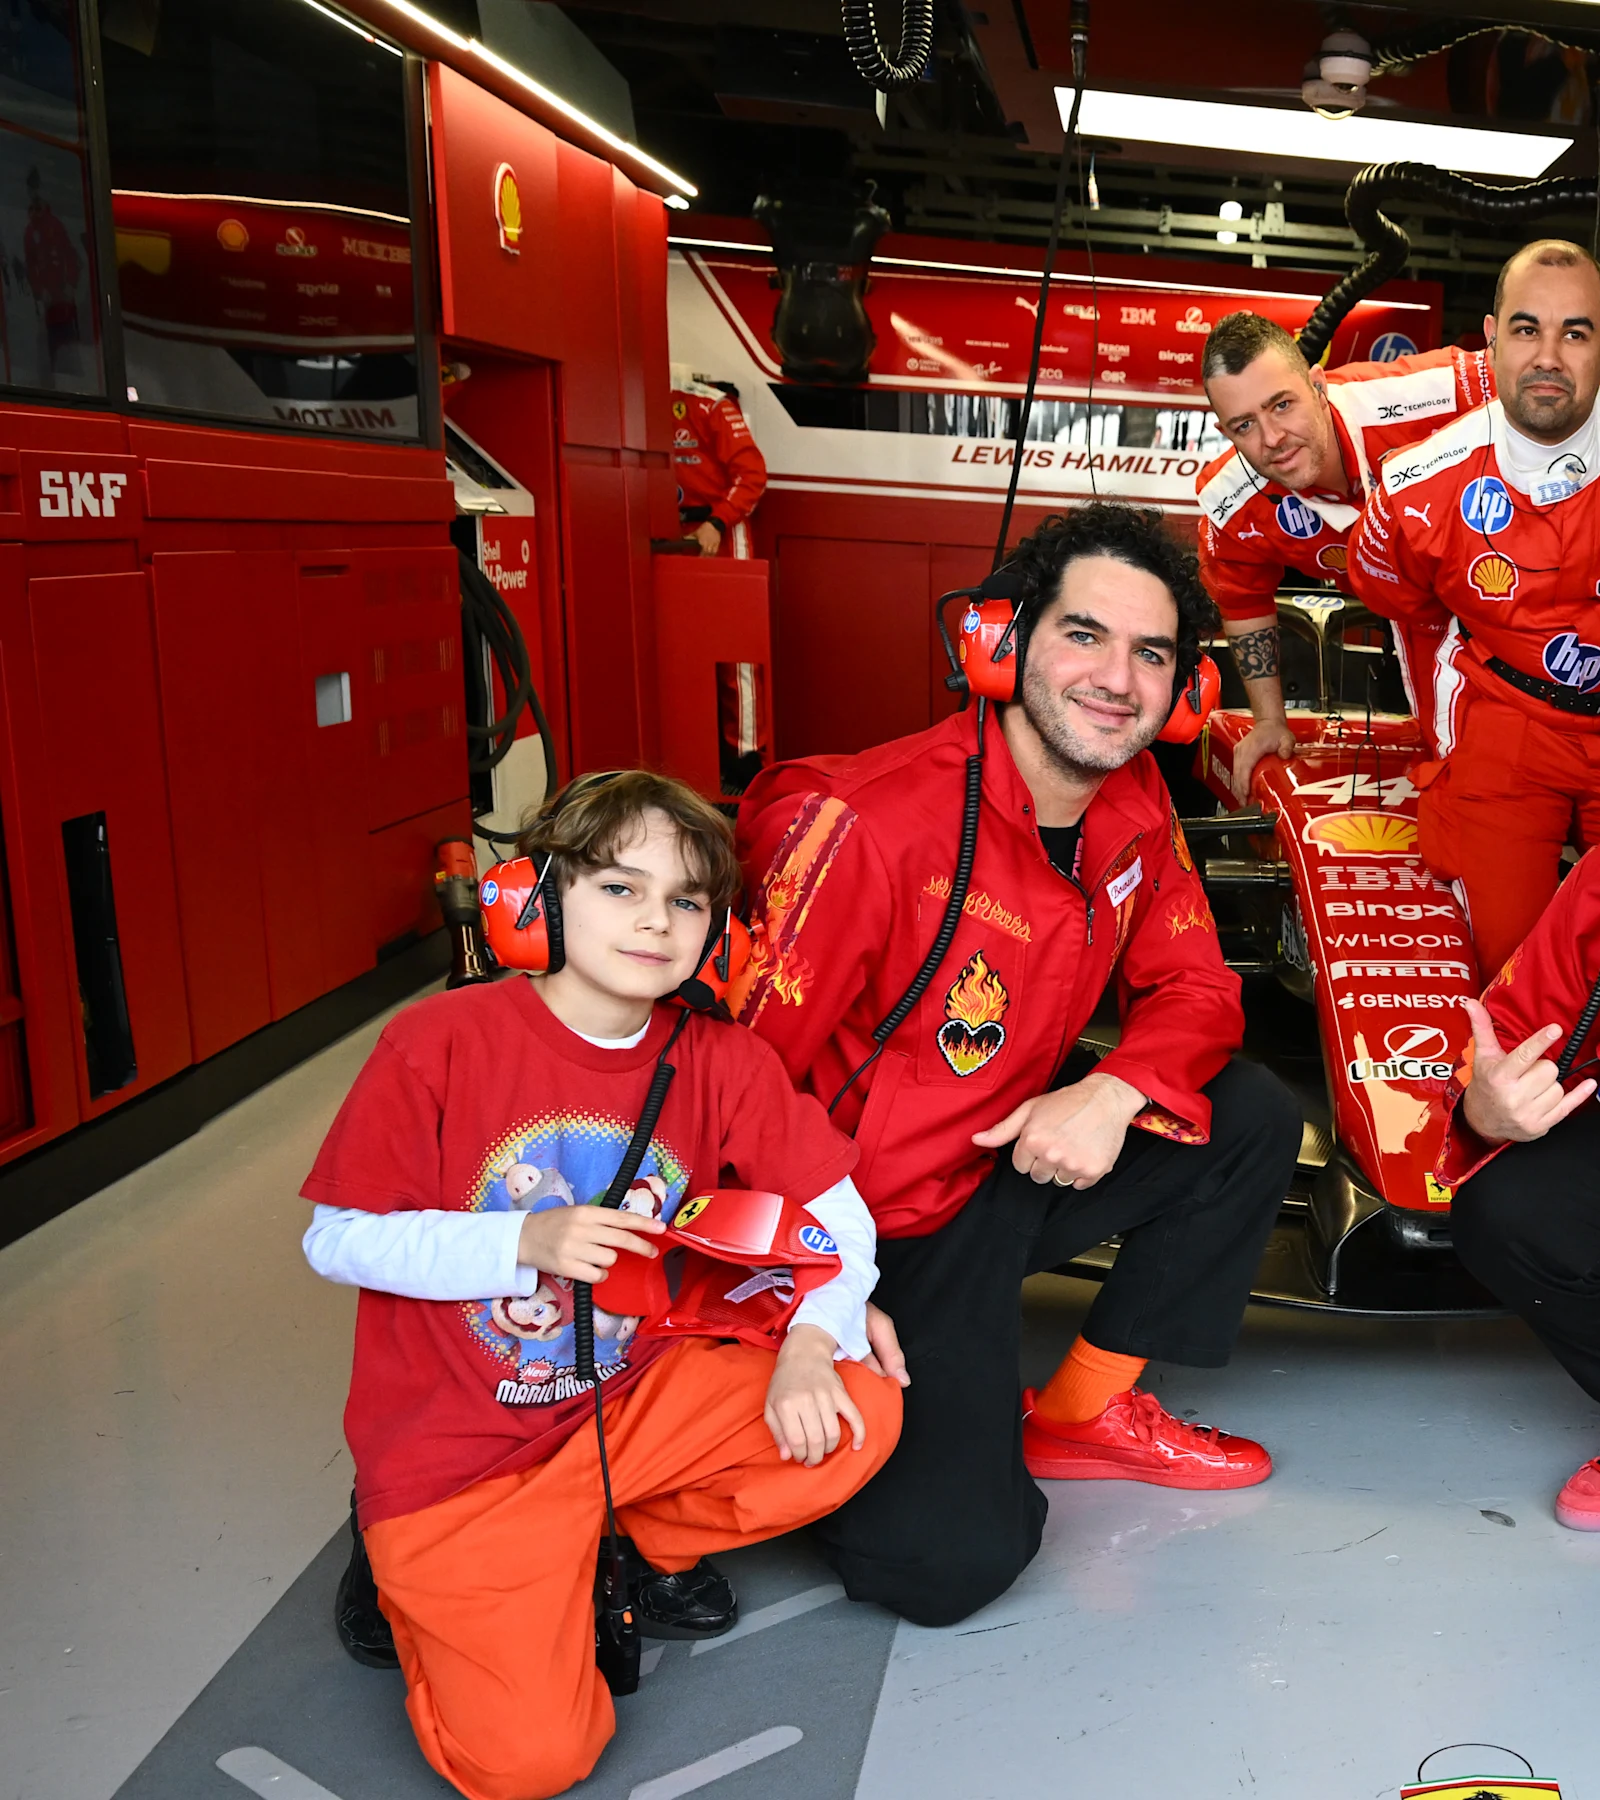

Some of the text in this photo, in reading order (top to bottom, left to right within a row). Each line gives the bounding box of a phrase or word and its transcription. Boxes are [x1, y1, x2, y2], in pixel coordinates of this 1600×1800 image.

[1120, 307, 1156, 325] IBM
[1378, 397, 1451, 419] DXC TECHNOLOGY
[952, 444, 1055, 469] LEWIS
[1390, 446, 1468, 488] DXC TECHNOLOGY
[39, 470, 127, 517] SKF
[1537, 479, 1582, 503] IBM
[1281, 495, 1316, 538] hp
[1467, 478, 1508, 533] hp
[485, 564, 527, 590] V-Power
[1291, 773, 1421, 806] 44
[1317, 866, 1452, 893] IBM
[1325, 933, 1463, 948] WHOOP
[1330, 960, 1471, 980] PIRELLI
[1359, 993, 1470, 1008] GENESYS
[1350, 1059, 1450, 1081] UniCre
[805, 1227, 836, 1252] hp
[524, 1366, 549, 1377] New
[496, 1379, 555, 1405] MARIO
